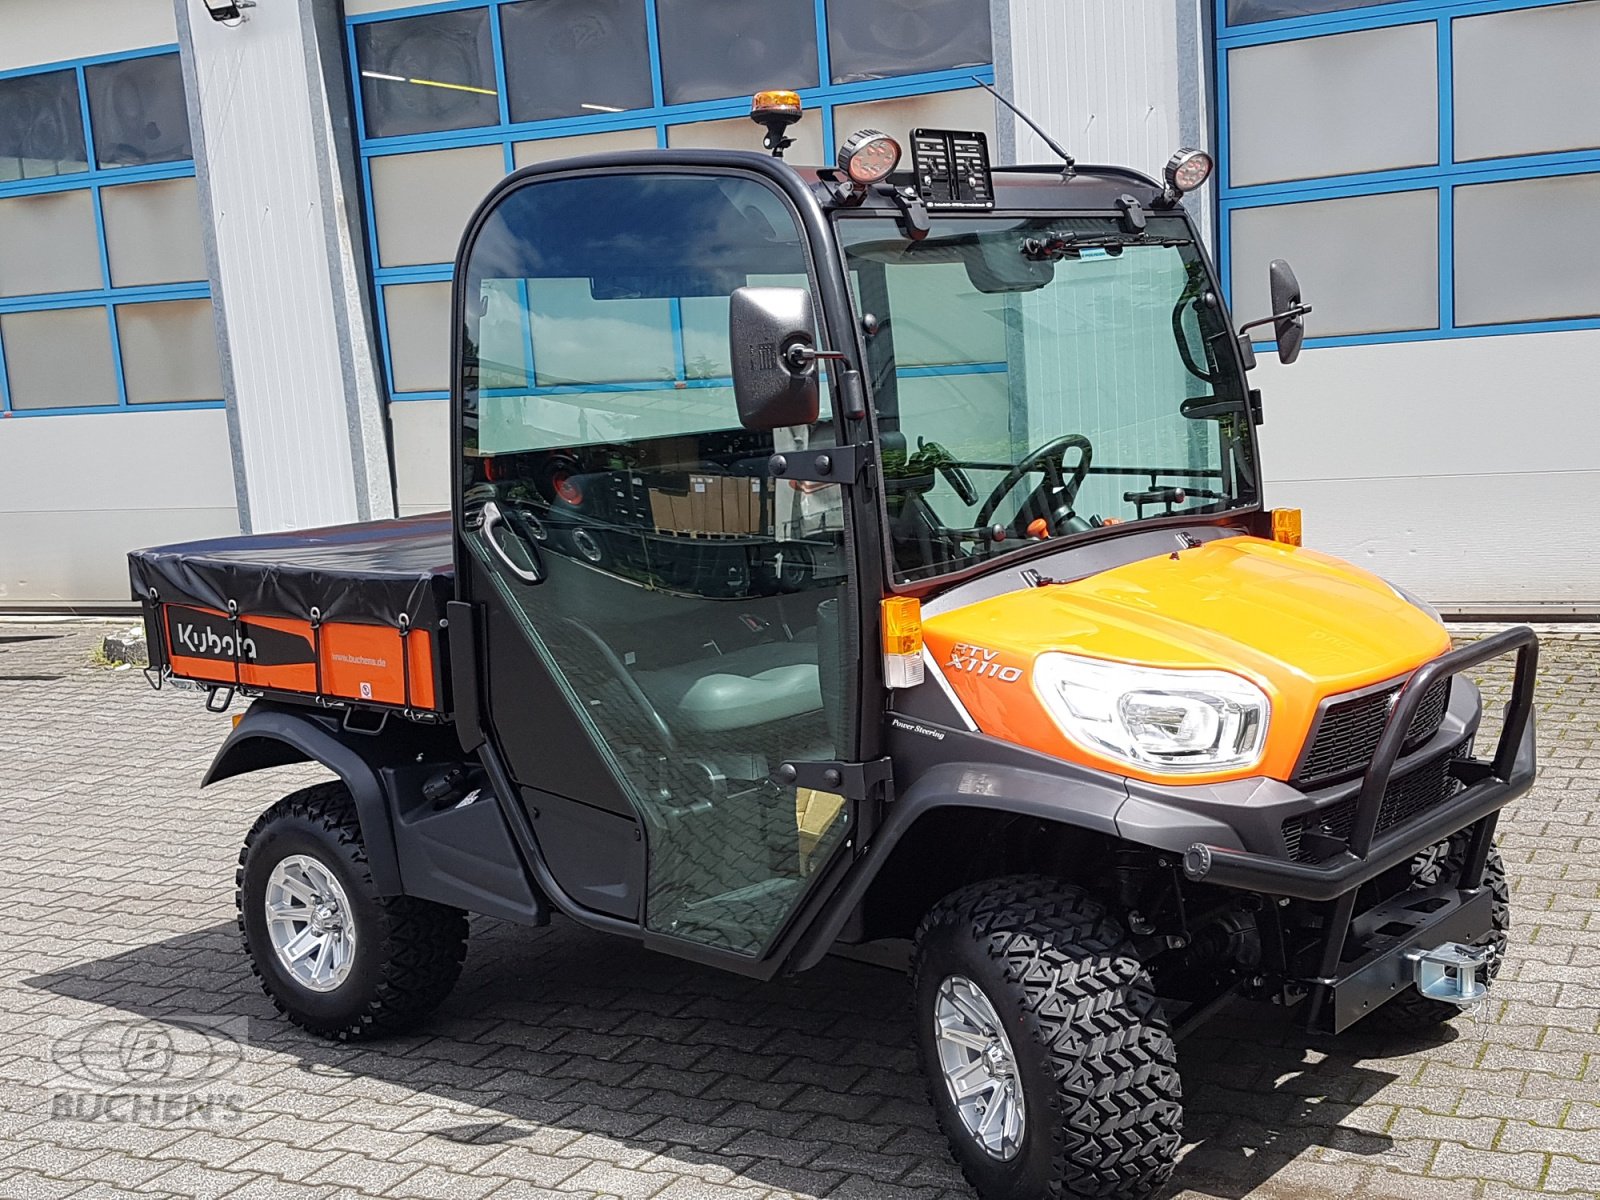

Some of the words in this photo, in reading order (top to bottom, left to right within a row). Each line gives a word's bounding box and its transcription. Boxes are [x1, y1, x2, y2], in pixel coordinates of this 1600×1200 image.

[178, 624, 256, 658] Kubota
[953, 643, 999, 661] RTV
[947, 654, 1023, 681] X1110
[892, 719, 914, 731] Power
[915, 725, 945, 740] Steering
